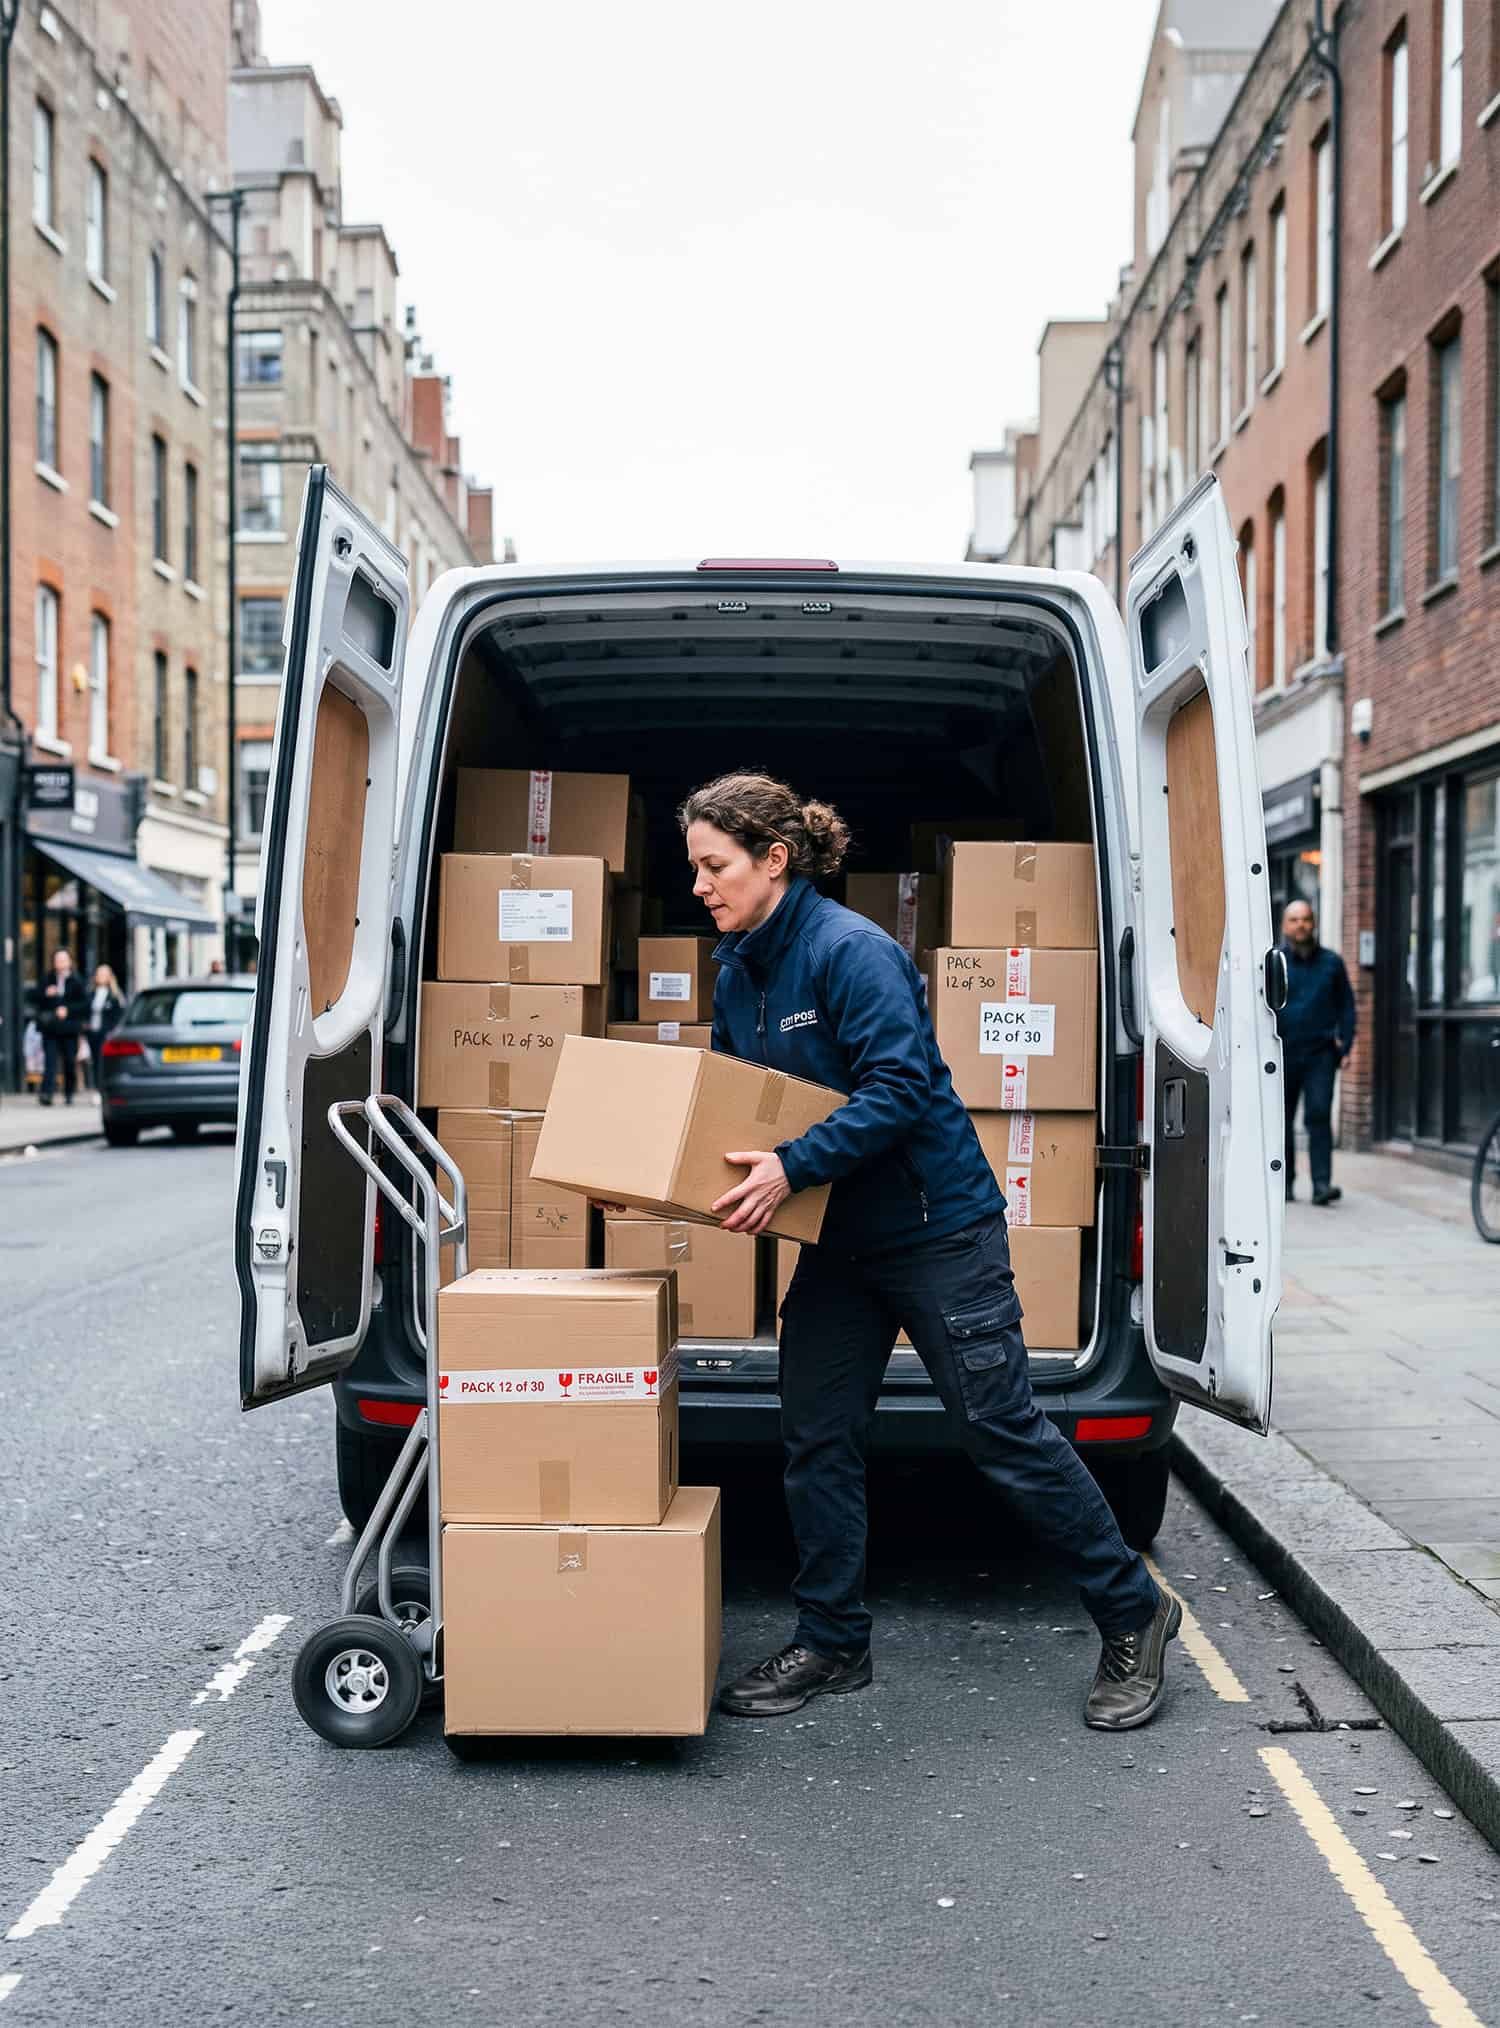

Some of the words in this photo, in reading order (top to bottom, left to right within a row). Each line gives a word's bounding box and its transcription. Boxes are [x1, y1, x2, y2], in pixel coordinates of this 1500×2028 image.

[947, 956, 982, 970] PACK
[946, 976, 959, 988] 12
[961, 976, 974, 991] of
[979, 976, 996, 988] 30
[983, 1012, 1026, 1024] PACK
[454, 1029, 492, 1048] PACK
[502, 1033, 516, 1047] 12
[520, 1033, 533, 1051] of
[537, 1034, 554, 1048] 30
[984, 1030, 1000, 1042] 12
[1005, 1030, 1020, 1042] of
[1024, 1031, 1041, 1043] 30
[578, 1372, 634, 1384] FRAGILE
[461, 1382, 496, 1393] PACK
[499, 1381, 512, 1393] 12
[516, 1381, 528, 1392] of
[530, 1381, 545, 1392] 30
